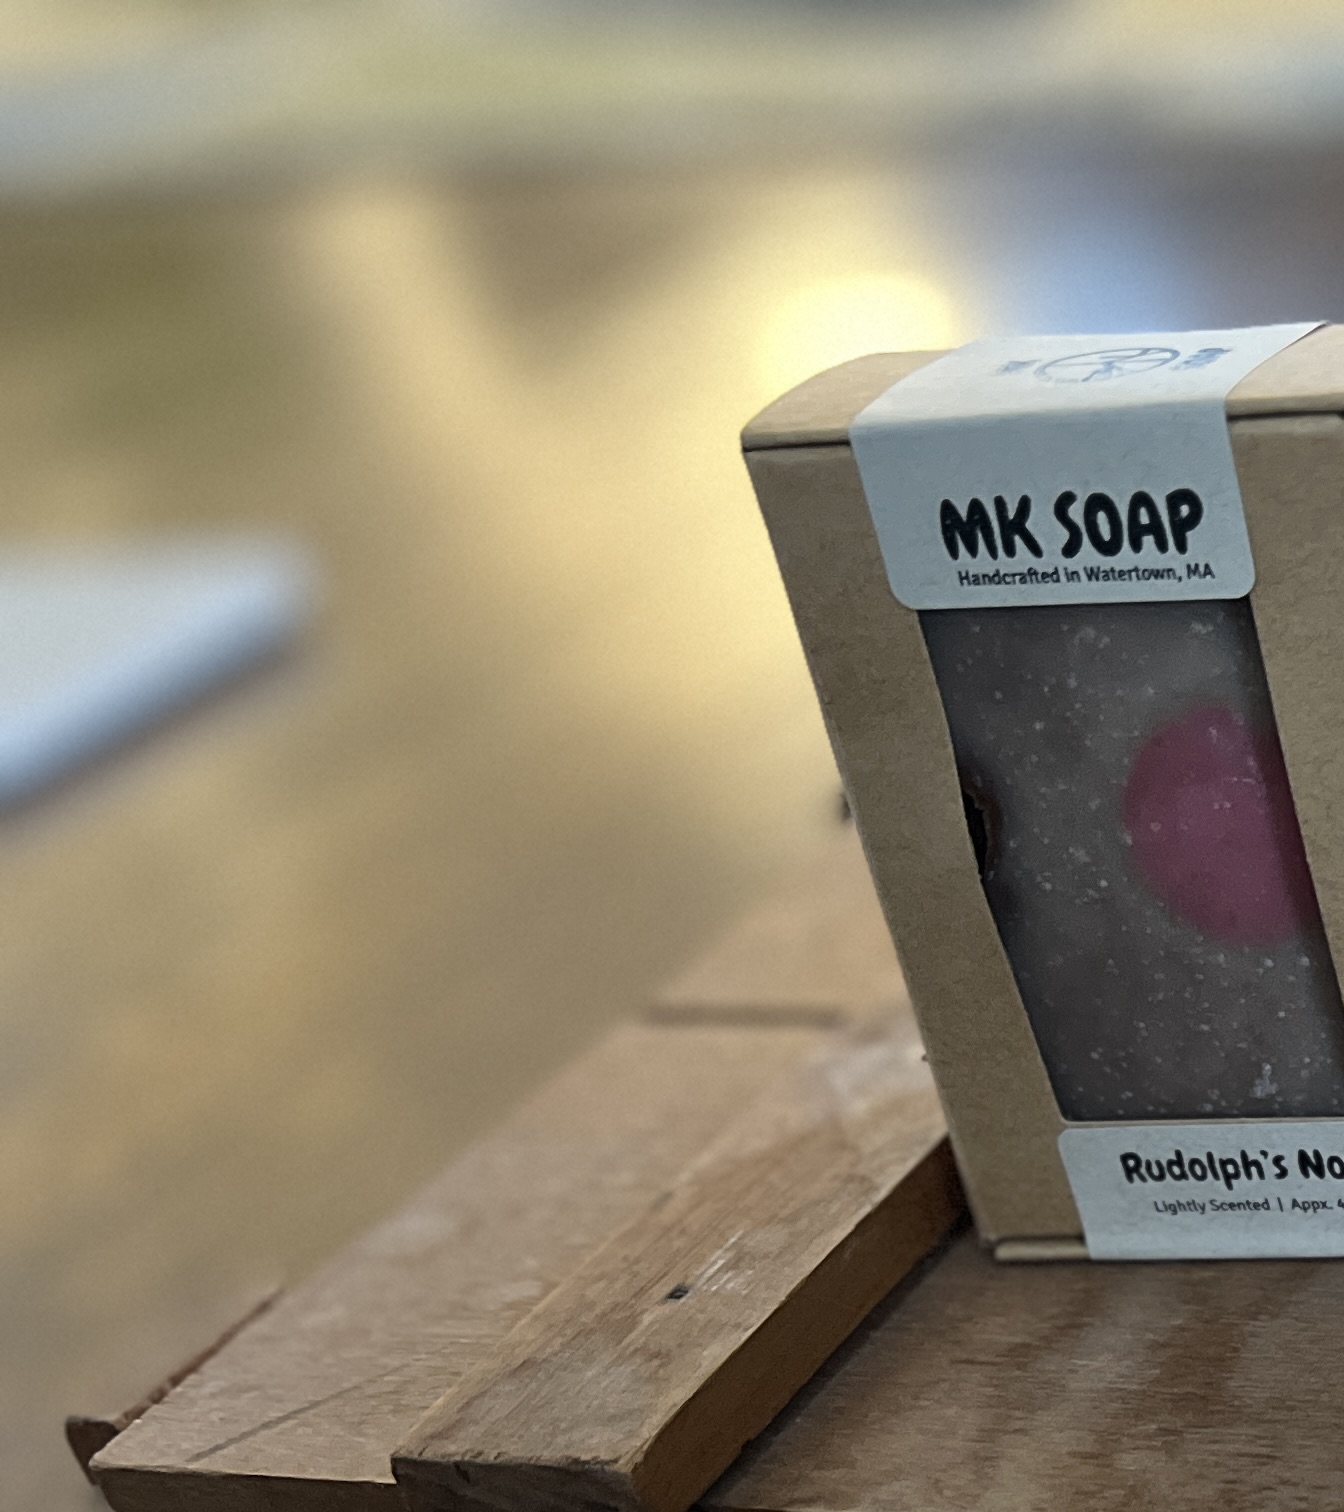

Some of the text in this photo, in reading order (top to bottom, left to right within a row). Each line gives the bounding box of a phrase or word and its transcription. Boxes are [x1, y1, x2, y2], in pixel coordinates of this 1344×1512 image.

[938, 487, 1204, 561] MK SOAP
[957, 561, 1217, 588] Handcrafted in Watertown, MA
[1119, 1149, 1289, 1191] Rudolph's
[1153, 1198, 1206, 1215] Lightly
[1209, 1197, 1271, 1213] Scented
[1290, 1197, 1335, 1214] Appx.
